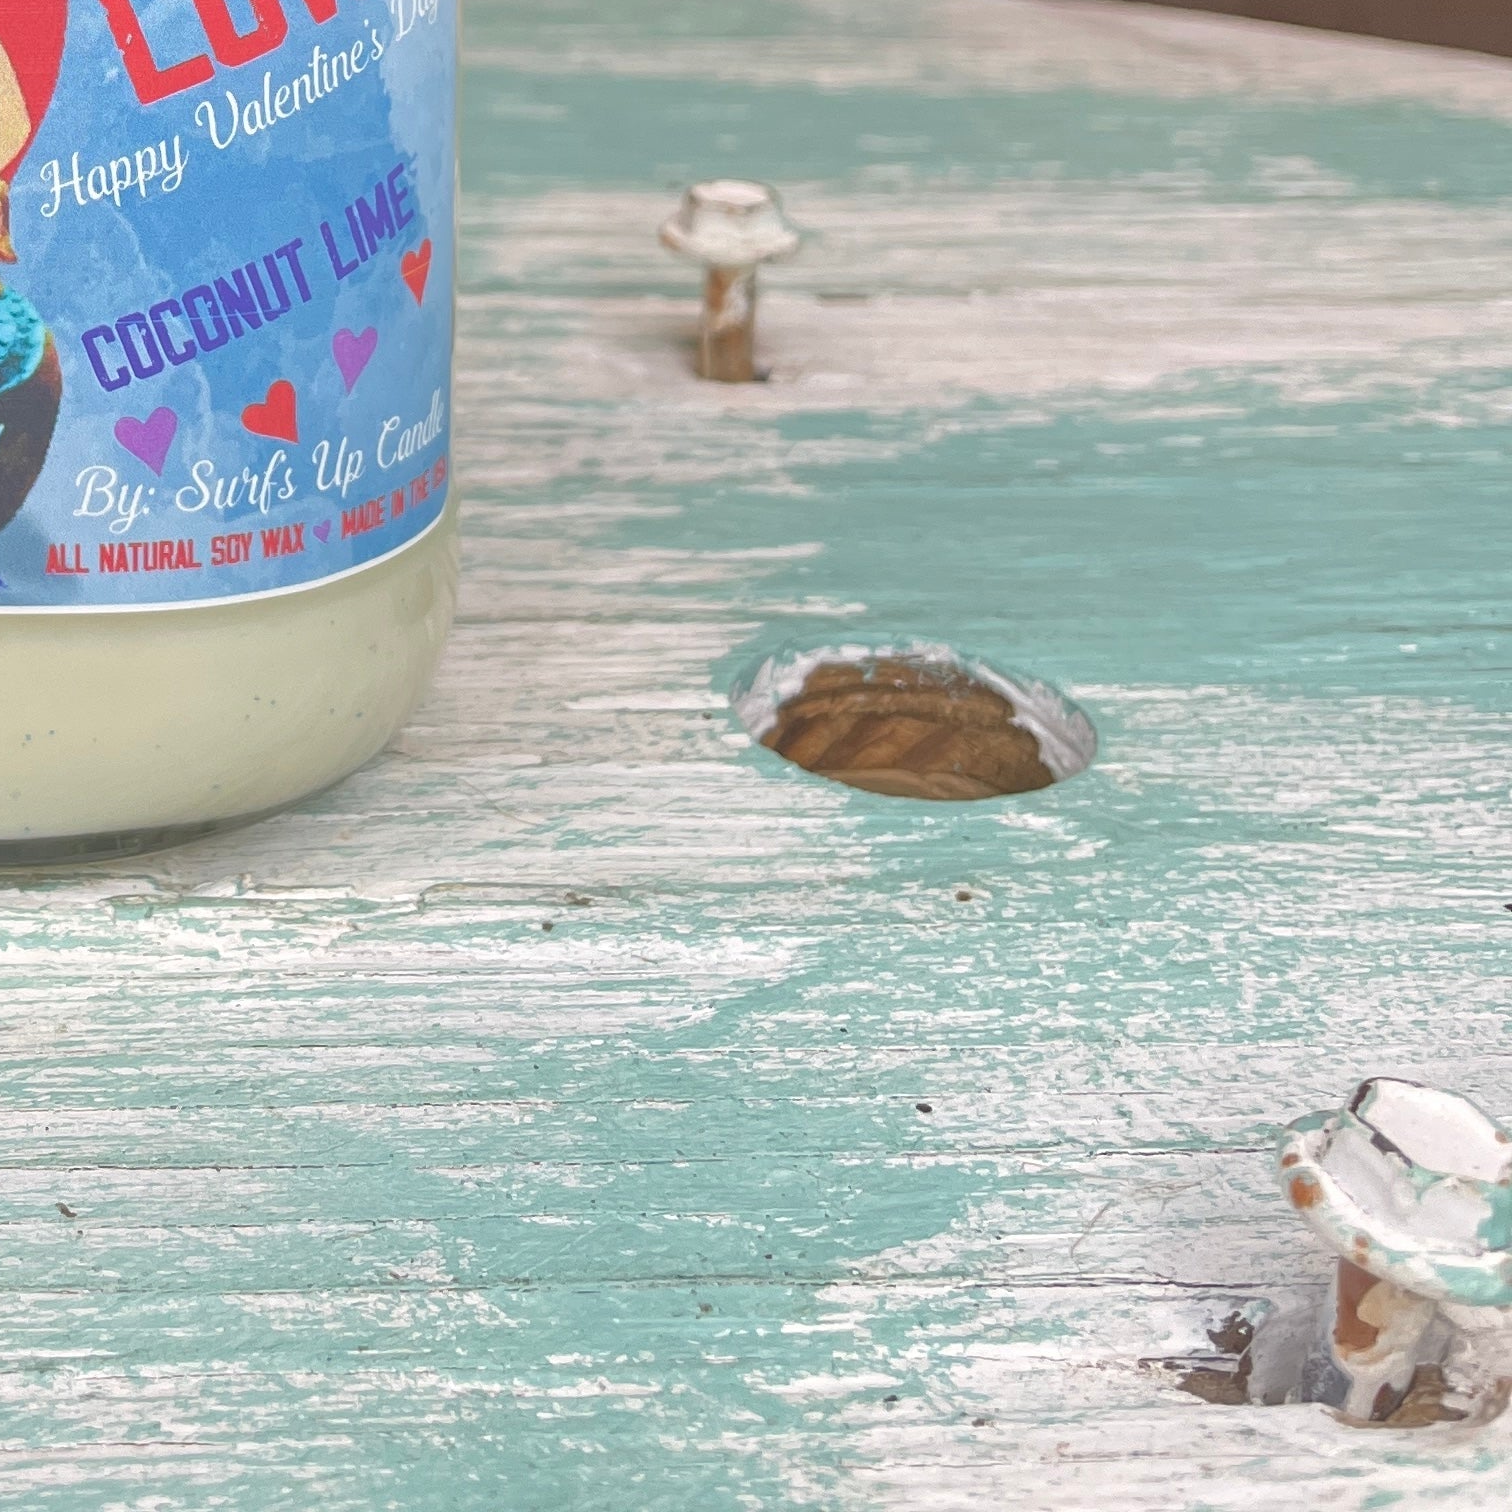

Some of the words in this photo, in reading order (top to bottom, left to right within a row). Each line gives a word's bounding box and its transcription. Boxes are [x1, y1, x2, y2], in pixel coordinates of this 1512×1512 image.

[39, 135, 189, 218] Happy
[194, 19, 384, 150] Valentine's
[81, 238, 312, 392] COCONUT
[319, 163, 415, 280] LIME
[45, 543, 89, 576] ALL
[99, 539, 202, 574] NATURAL
[211, 532, 254, 567] SOY
[260, 522, 306, 559] WAX
[341, 495, 386, 540] MADE
[391, 486, 405, 520] IN
[72, 464, 156, 535] By:
[312, 436, 367, 499] Up
